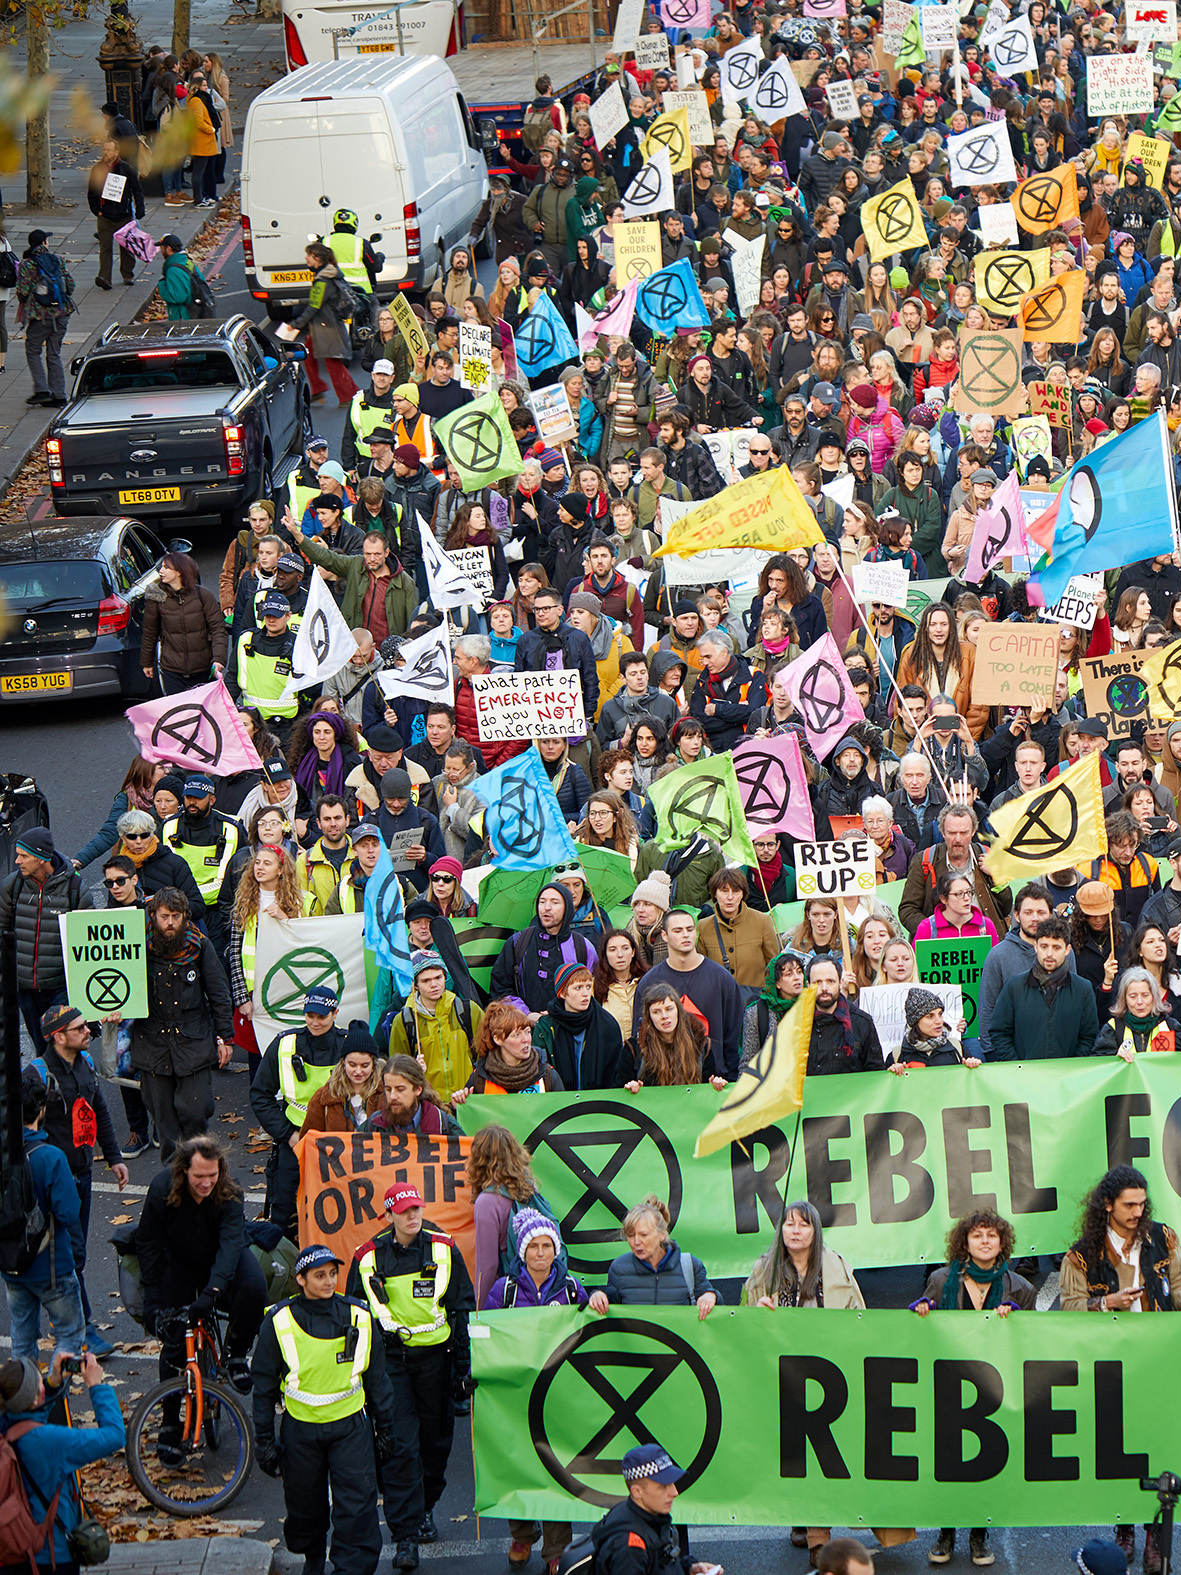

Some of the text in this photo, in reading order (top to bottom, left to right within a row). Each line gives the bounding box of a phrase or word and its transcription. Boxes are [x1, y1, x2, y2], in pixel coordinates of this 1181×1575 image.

[1135, 10, 1168, 23] LOVE
[1091, 54, 1145, 69] Be on the
[1092, 65, 1118, 80] right
[1090, 76, 1149, 89] of History
[1090, 87, 1152, 100] or be at the
[1090, 99, 1153, 114] end of History
[1140, 139, 1158, 150] SAVE
[1140, 148, 1156, 157] OUR
[626, 226, 647, 235] SAVE
[629, 236, 646, 245] OUR
[619, 244, 657, 255] CHILDREN
[274, 273, 297, 282] KN63
[461, 326, 491, 344] DECLARE
[461, 343, 491, 359] CLIMATE
[1035, 383, 1070, 401] WAKE
[1041, 399, 1068, 412] AND
[72, 464, 222, 483] RANGER
[123, 489, 175, 503] LT68 OTV
[464, 549, 485, 561] CAN
[466, 561, 484, 571] LET
[875, 586, 896, 598] ELSE
[1068, 585, 1096, 600] Planet
[988, 662, 1054, 676] TOO LATE
[1085, 660, 1132, 680] There
[5, 674, 65, 690] KS58 YUG
[523, 673, 555, 691] part
[559, 674, 578, 689] of
[1000, 680, 1011, 693] A
[478, 691, 579, 712] EMERGENCY
[480, 714, 497, 727] do
[502, 710, 529, 725] you
[1095, 707, 1156, 736] Plaet
[800, 840, 869, 867] RISE
[816, 867, 856, 894] UP
[87, 924, 125, 942] NON
[71, 943, 142, 963] VIOLENT
[930, 949, 977, 968] REBEL
[920, 967, 983, 984] FOR LIF
[315, 1132, 468, 1183] REBEL
[730, 1102, 1058, 1235] REBEL
[396, 1190, 418, 1200] POLICE
[310, 1177, 378, 1235] OR
[778, 1355, 1150, 1483] REBEL
